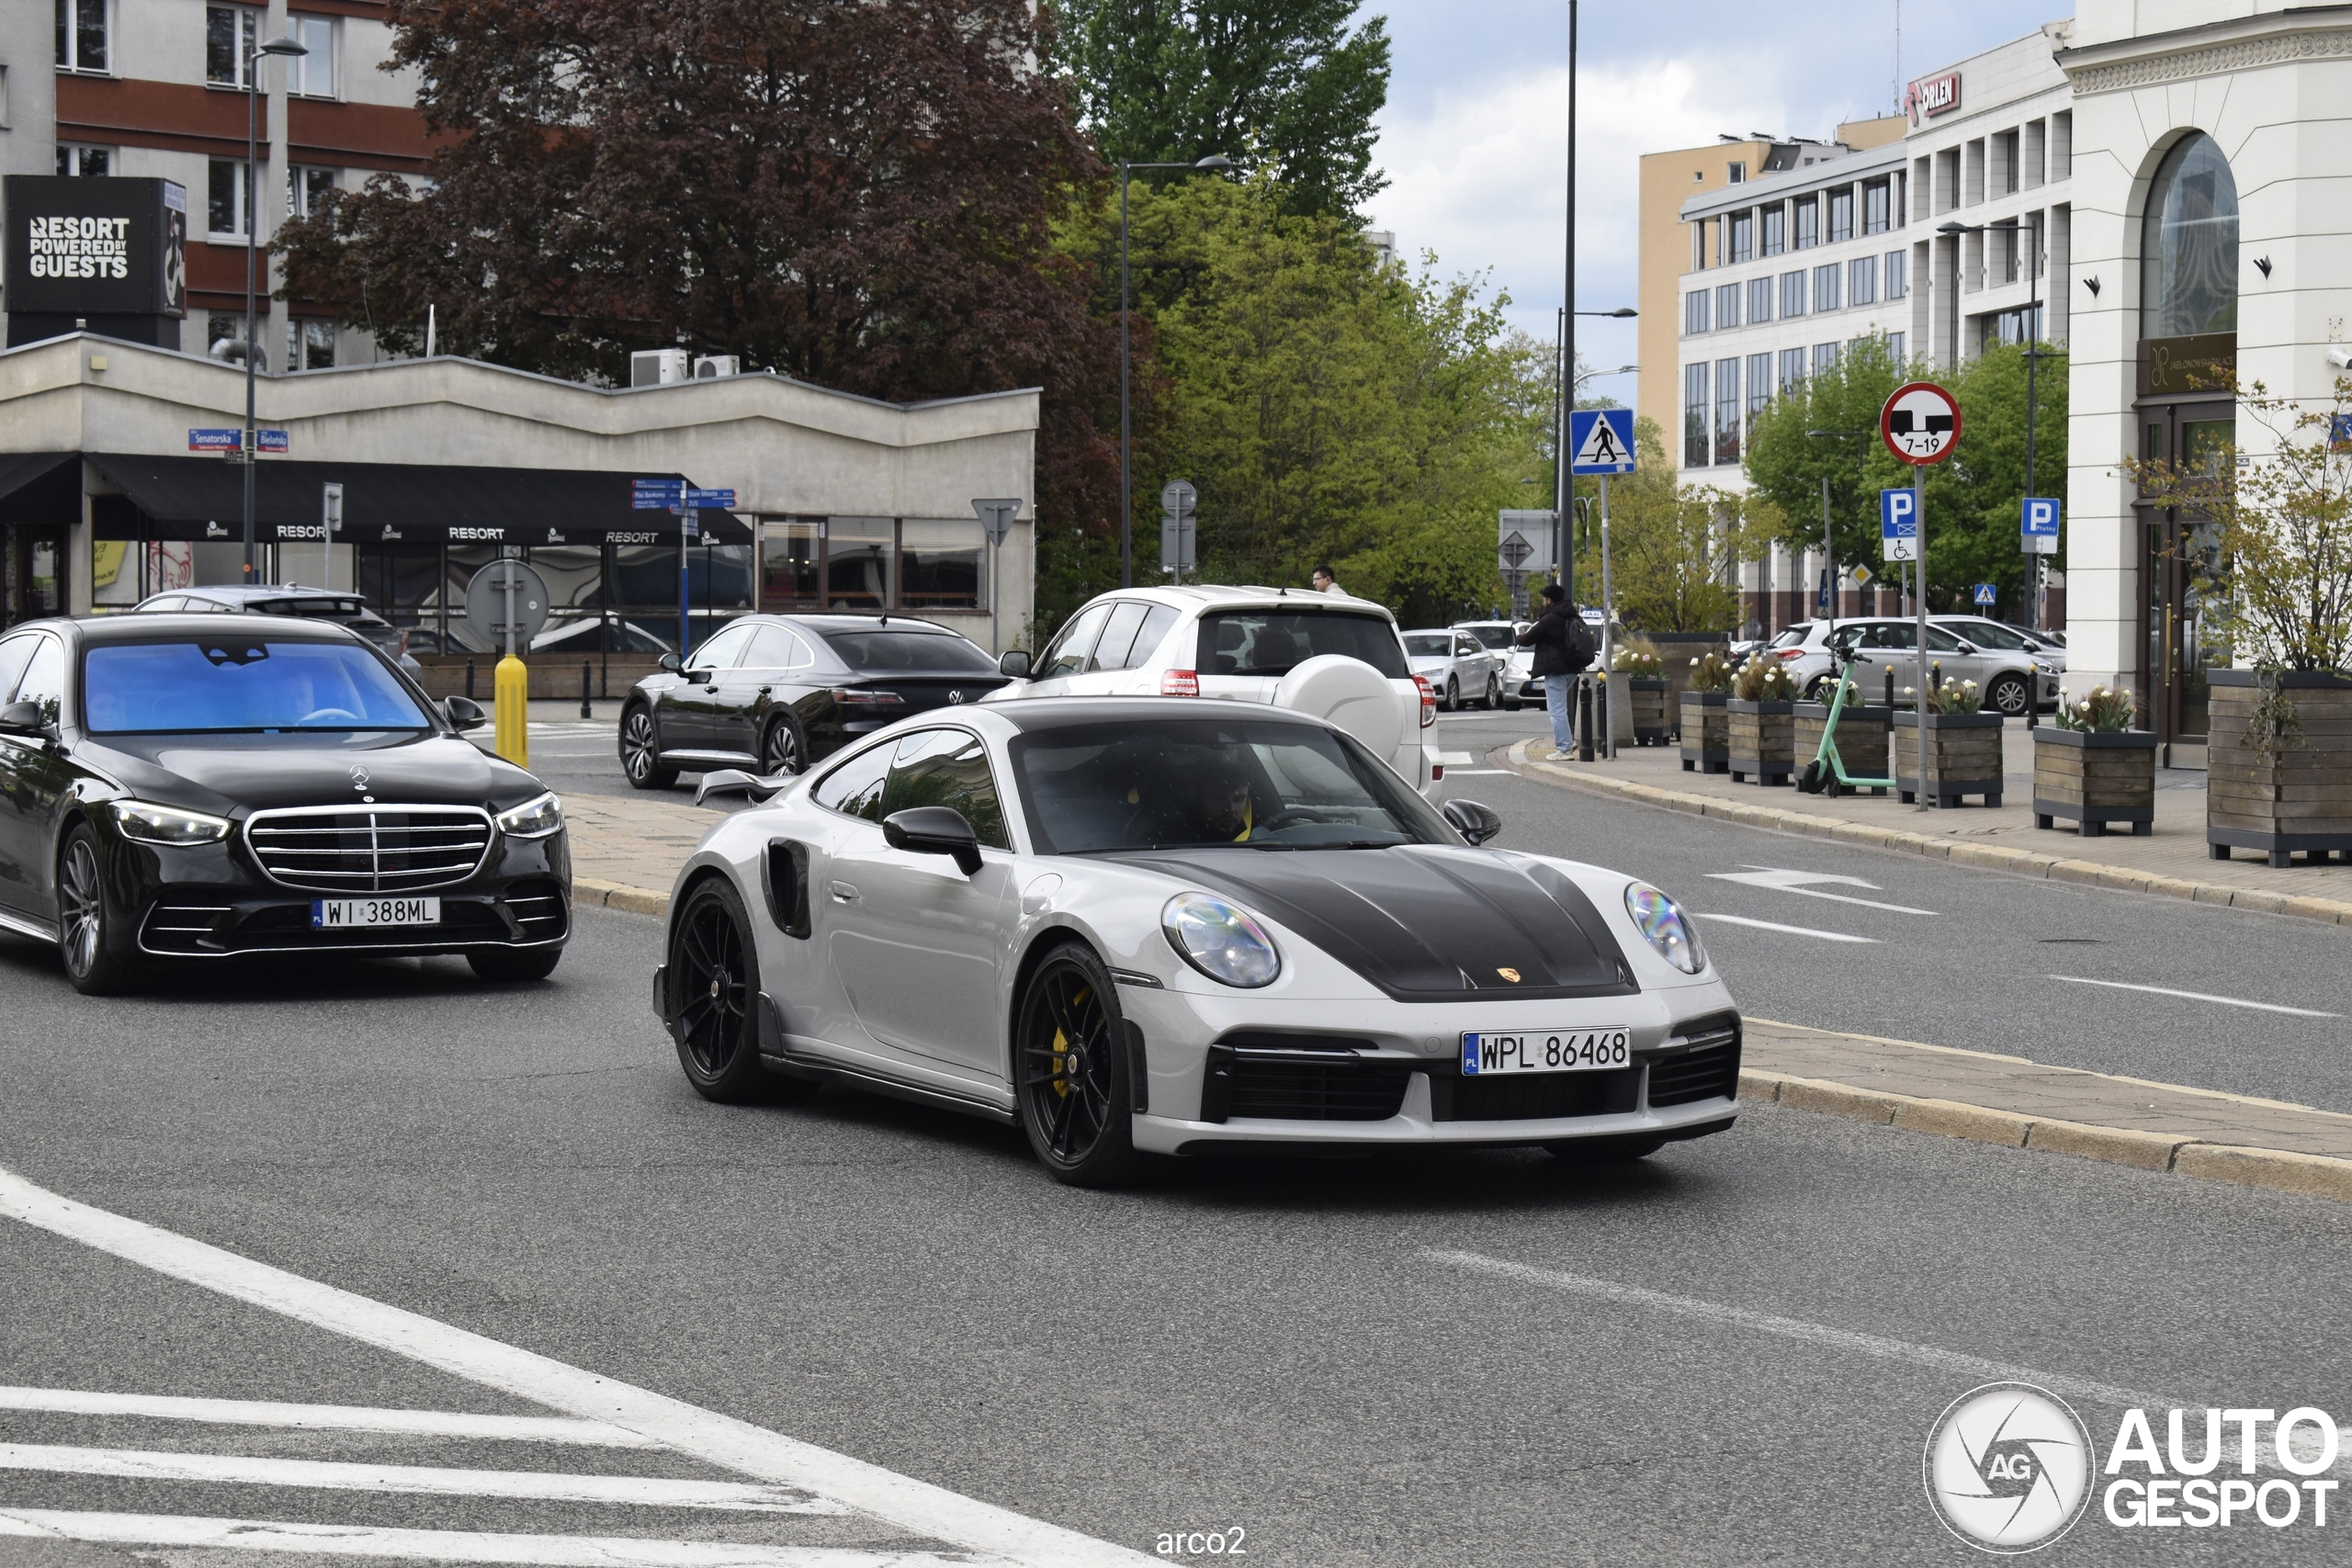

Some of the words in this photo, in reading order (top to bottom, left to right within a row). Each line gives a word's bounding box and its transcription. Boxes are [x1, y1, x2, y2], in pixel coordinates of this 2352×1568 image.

[1923, 77, 1952, 111] ORLEN
[30, 217, 130, 239] RESORT
[30, 239, 115, 255] POWERED
[115, 240, 127, 250] BY
[30, 254, 128, 278] GUESTS
[196, 434, 232, 444] Senatorska
[1905, 437, 1939, 453] 7-19
[1890, 493, 1912, 524] P
[2030, 502, 2052, 531] P
[277, 525, 327, 537] RESOR
[449, 527, 504, 539] RESORT
[606, 532, 658, 543] RESORT
[328, 901, 352, 924] WI
[368, 900, 434, 922] 388ML
[1481, 1036, 1534, 1069] WPL
[1545, 1032, 1626, 1067] 86468
[1465, 1058, 1476, 1067] PL
